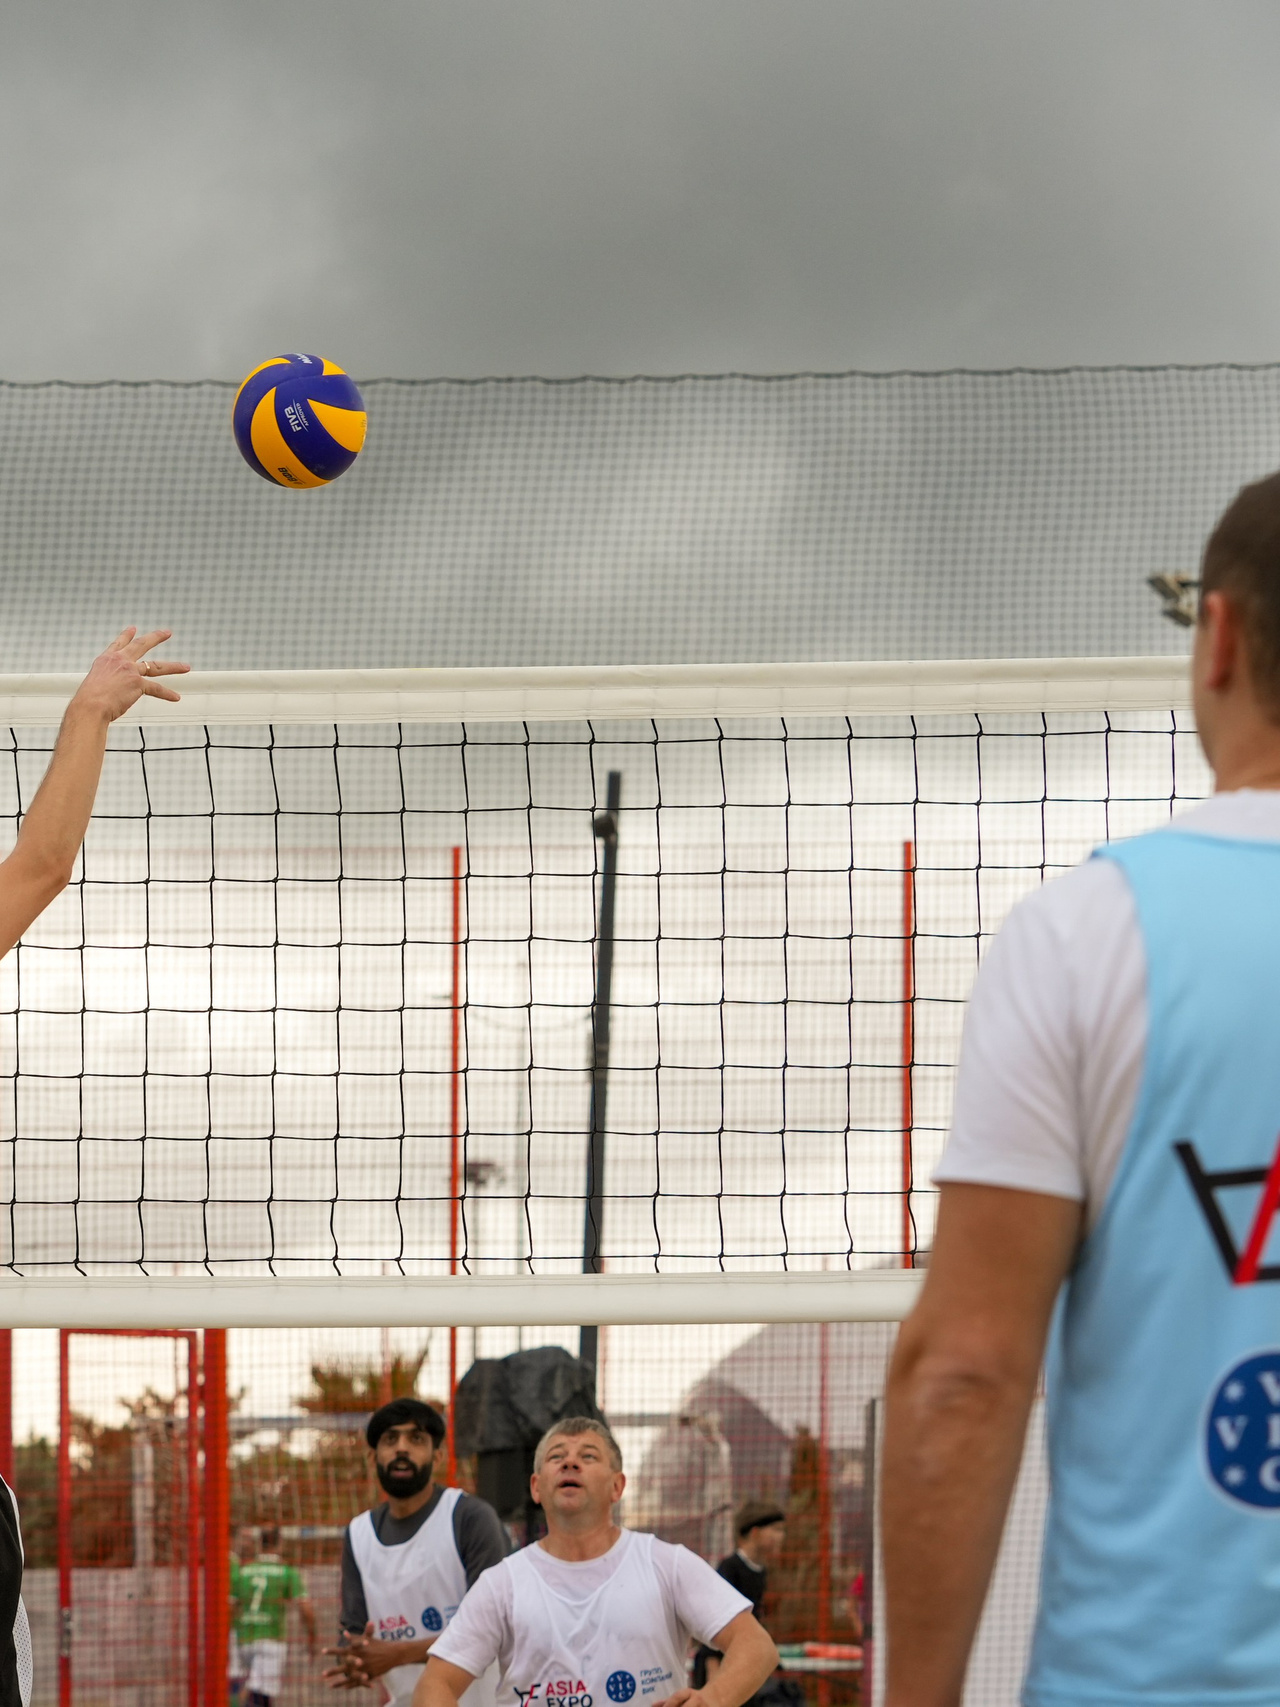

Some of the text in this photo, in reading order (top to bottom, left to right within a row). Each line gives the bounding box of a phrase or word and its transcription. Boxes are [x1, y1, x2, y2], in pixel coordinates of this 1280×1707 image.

[284, 406, 302, 432] FIVB
[379, 1615, 408, 1631] ASA
[546, 1679, 587, 1696] ASIA
